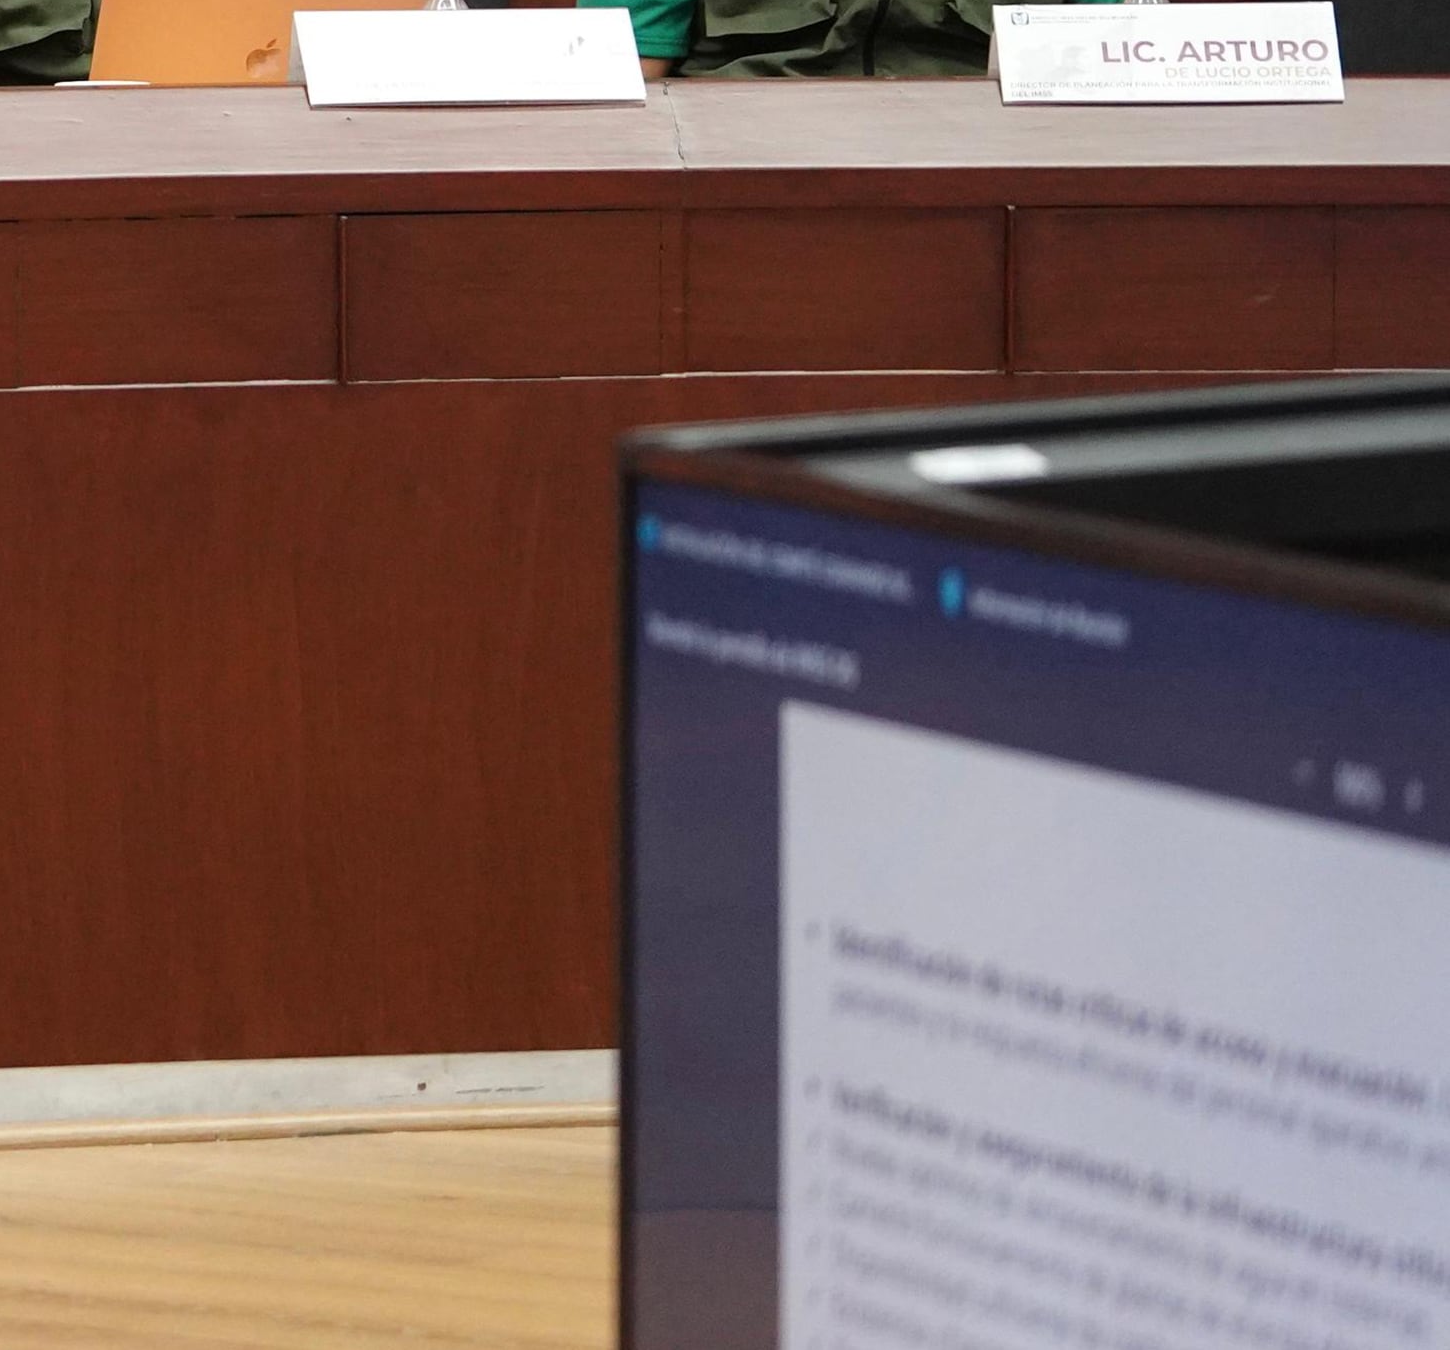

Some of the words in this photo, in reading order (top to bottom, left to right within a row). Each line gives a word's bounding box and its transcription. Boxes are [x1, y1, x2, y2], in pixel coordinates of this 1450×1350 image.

[1101, 41, 1166, 63] LIC.
[1177, 39, 1329, 62] ARTURO
[1165, 67, 1189, 78] DE
[1196, 66, 1251, 78] LUCIO
[1257, 65, 1332, 78] ORTEGA
